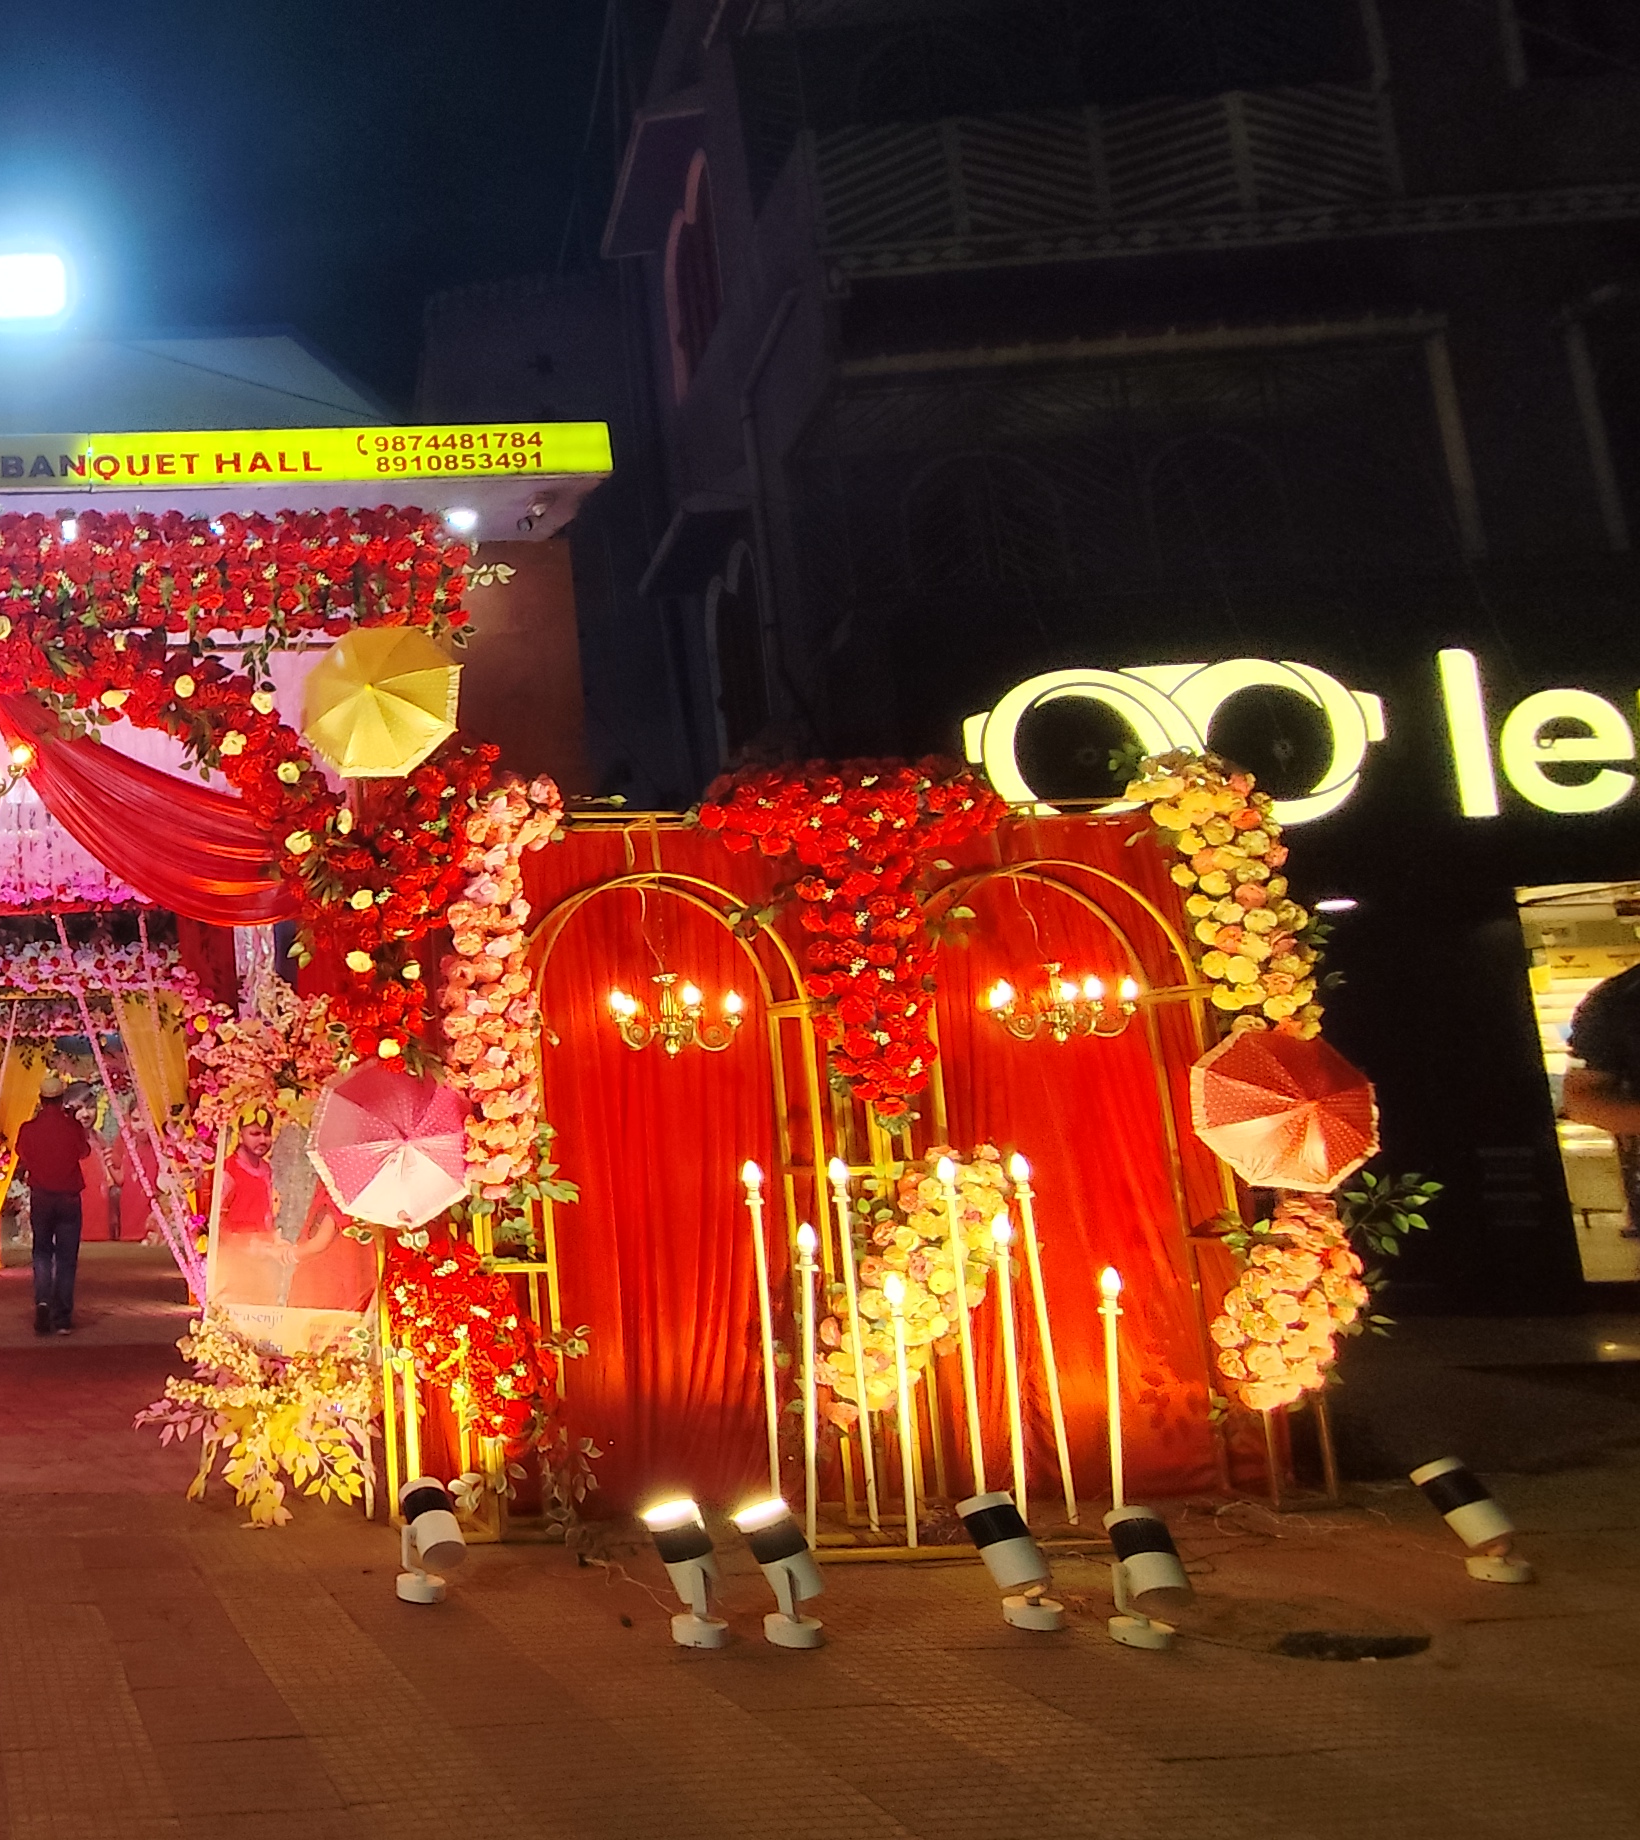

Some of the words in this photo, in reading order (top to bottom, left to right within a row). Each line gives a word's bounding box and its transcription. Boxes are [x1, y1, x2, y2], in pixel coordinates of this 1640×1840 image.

[374, 431, 543, 452] 9874481784
[0, 453, 200, 481] BANQUET
[215, 450, 323, 474] HALL
[376, 451, 542, 473] 8910853491
[1437, 648, 1640, 817] le
